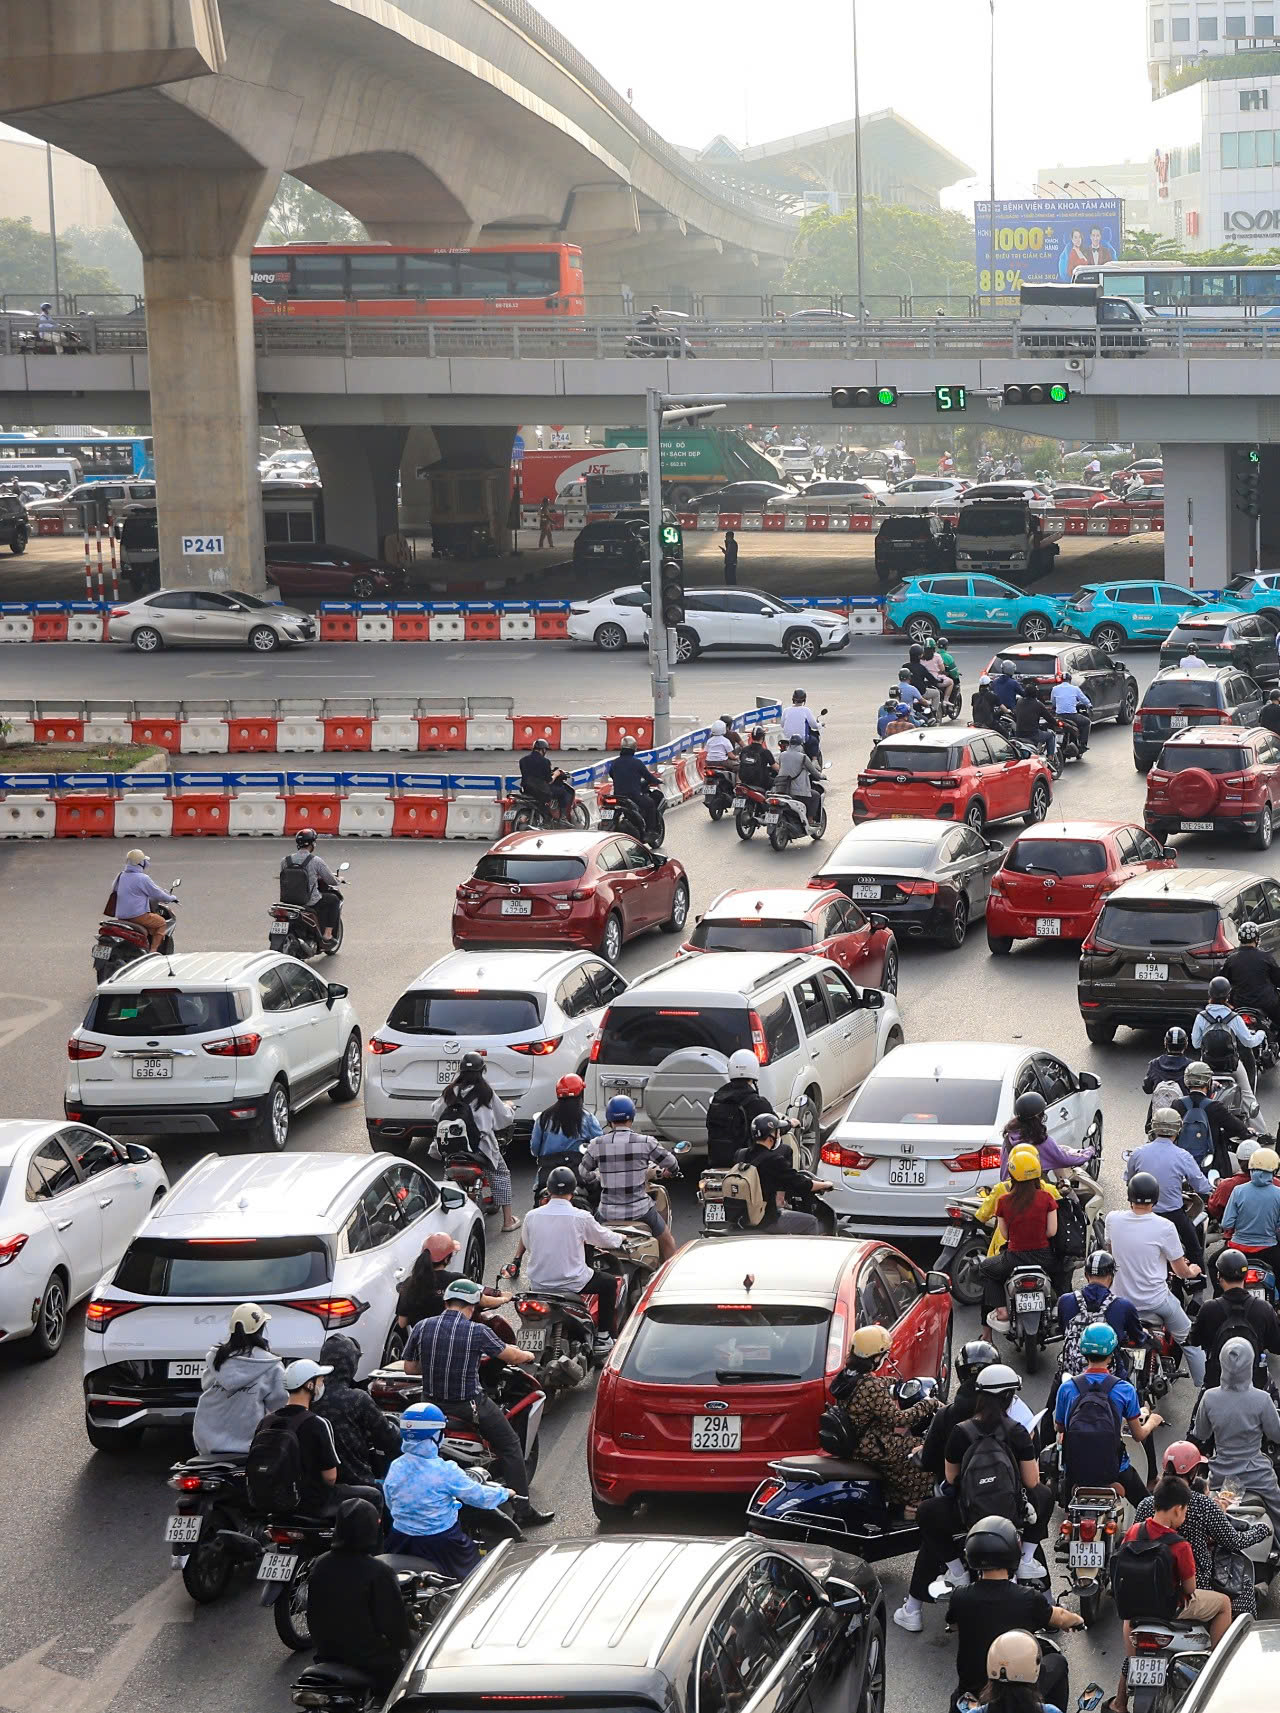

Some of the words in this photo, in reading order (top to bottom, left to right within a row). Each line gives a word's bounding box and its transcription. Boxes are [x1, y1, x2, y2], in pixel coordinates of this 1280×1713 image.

[1003, 203, 1024, 212] BỆNH
[1025, 203, 1043, 212] VIỆN
[1058, 202, 1080, 210] KHOA
[1081, 201, 1098, 209] TÂM
[939, 388, 965, 409] 51
[184, 538, 222, 553] P241
[1043, 919, 1055, 927] 30E
[1138, 972, 1164, 980] 631.34
[446, 1061, 461, 1072] 30
[137, 1068, 168, 1077] 636.43
[438, 1072, 457, 1083] 887
[899, 1160, 917, 1171] 30F
[891, 1172, 925, 1184] 061.18
[706, 1212, 725, 1221] 591.4
[1018, 1302, 1043, 1311] 599.70
[521, 1331, 541, 1340] 19-H1
[518, 1340, 543, 1349] 073.28
[175, 1364, 204, 1376] 30H-
[704, 1417, 729, 1432] 29A
[694, 1433, 739, 1448] 323.07
[979, 1476, 997, 1485] acer
[172, 1517, 196, 1529] 29-AC
[169, 1529, 197, 1541] 195.02
[1076, 1546, 1099, 1554] 19-AL
[268, 1555, 292, 1567] 18-LA
[1071, 1555, 1103, 1566] 013.83
[261, 1567, 290, 1579] 106.10
[1135, 1659, 1161, 1671] 18-B1
[1129, 1672, 1164, 1685] 432.50
